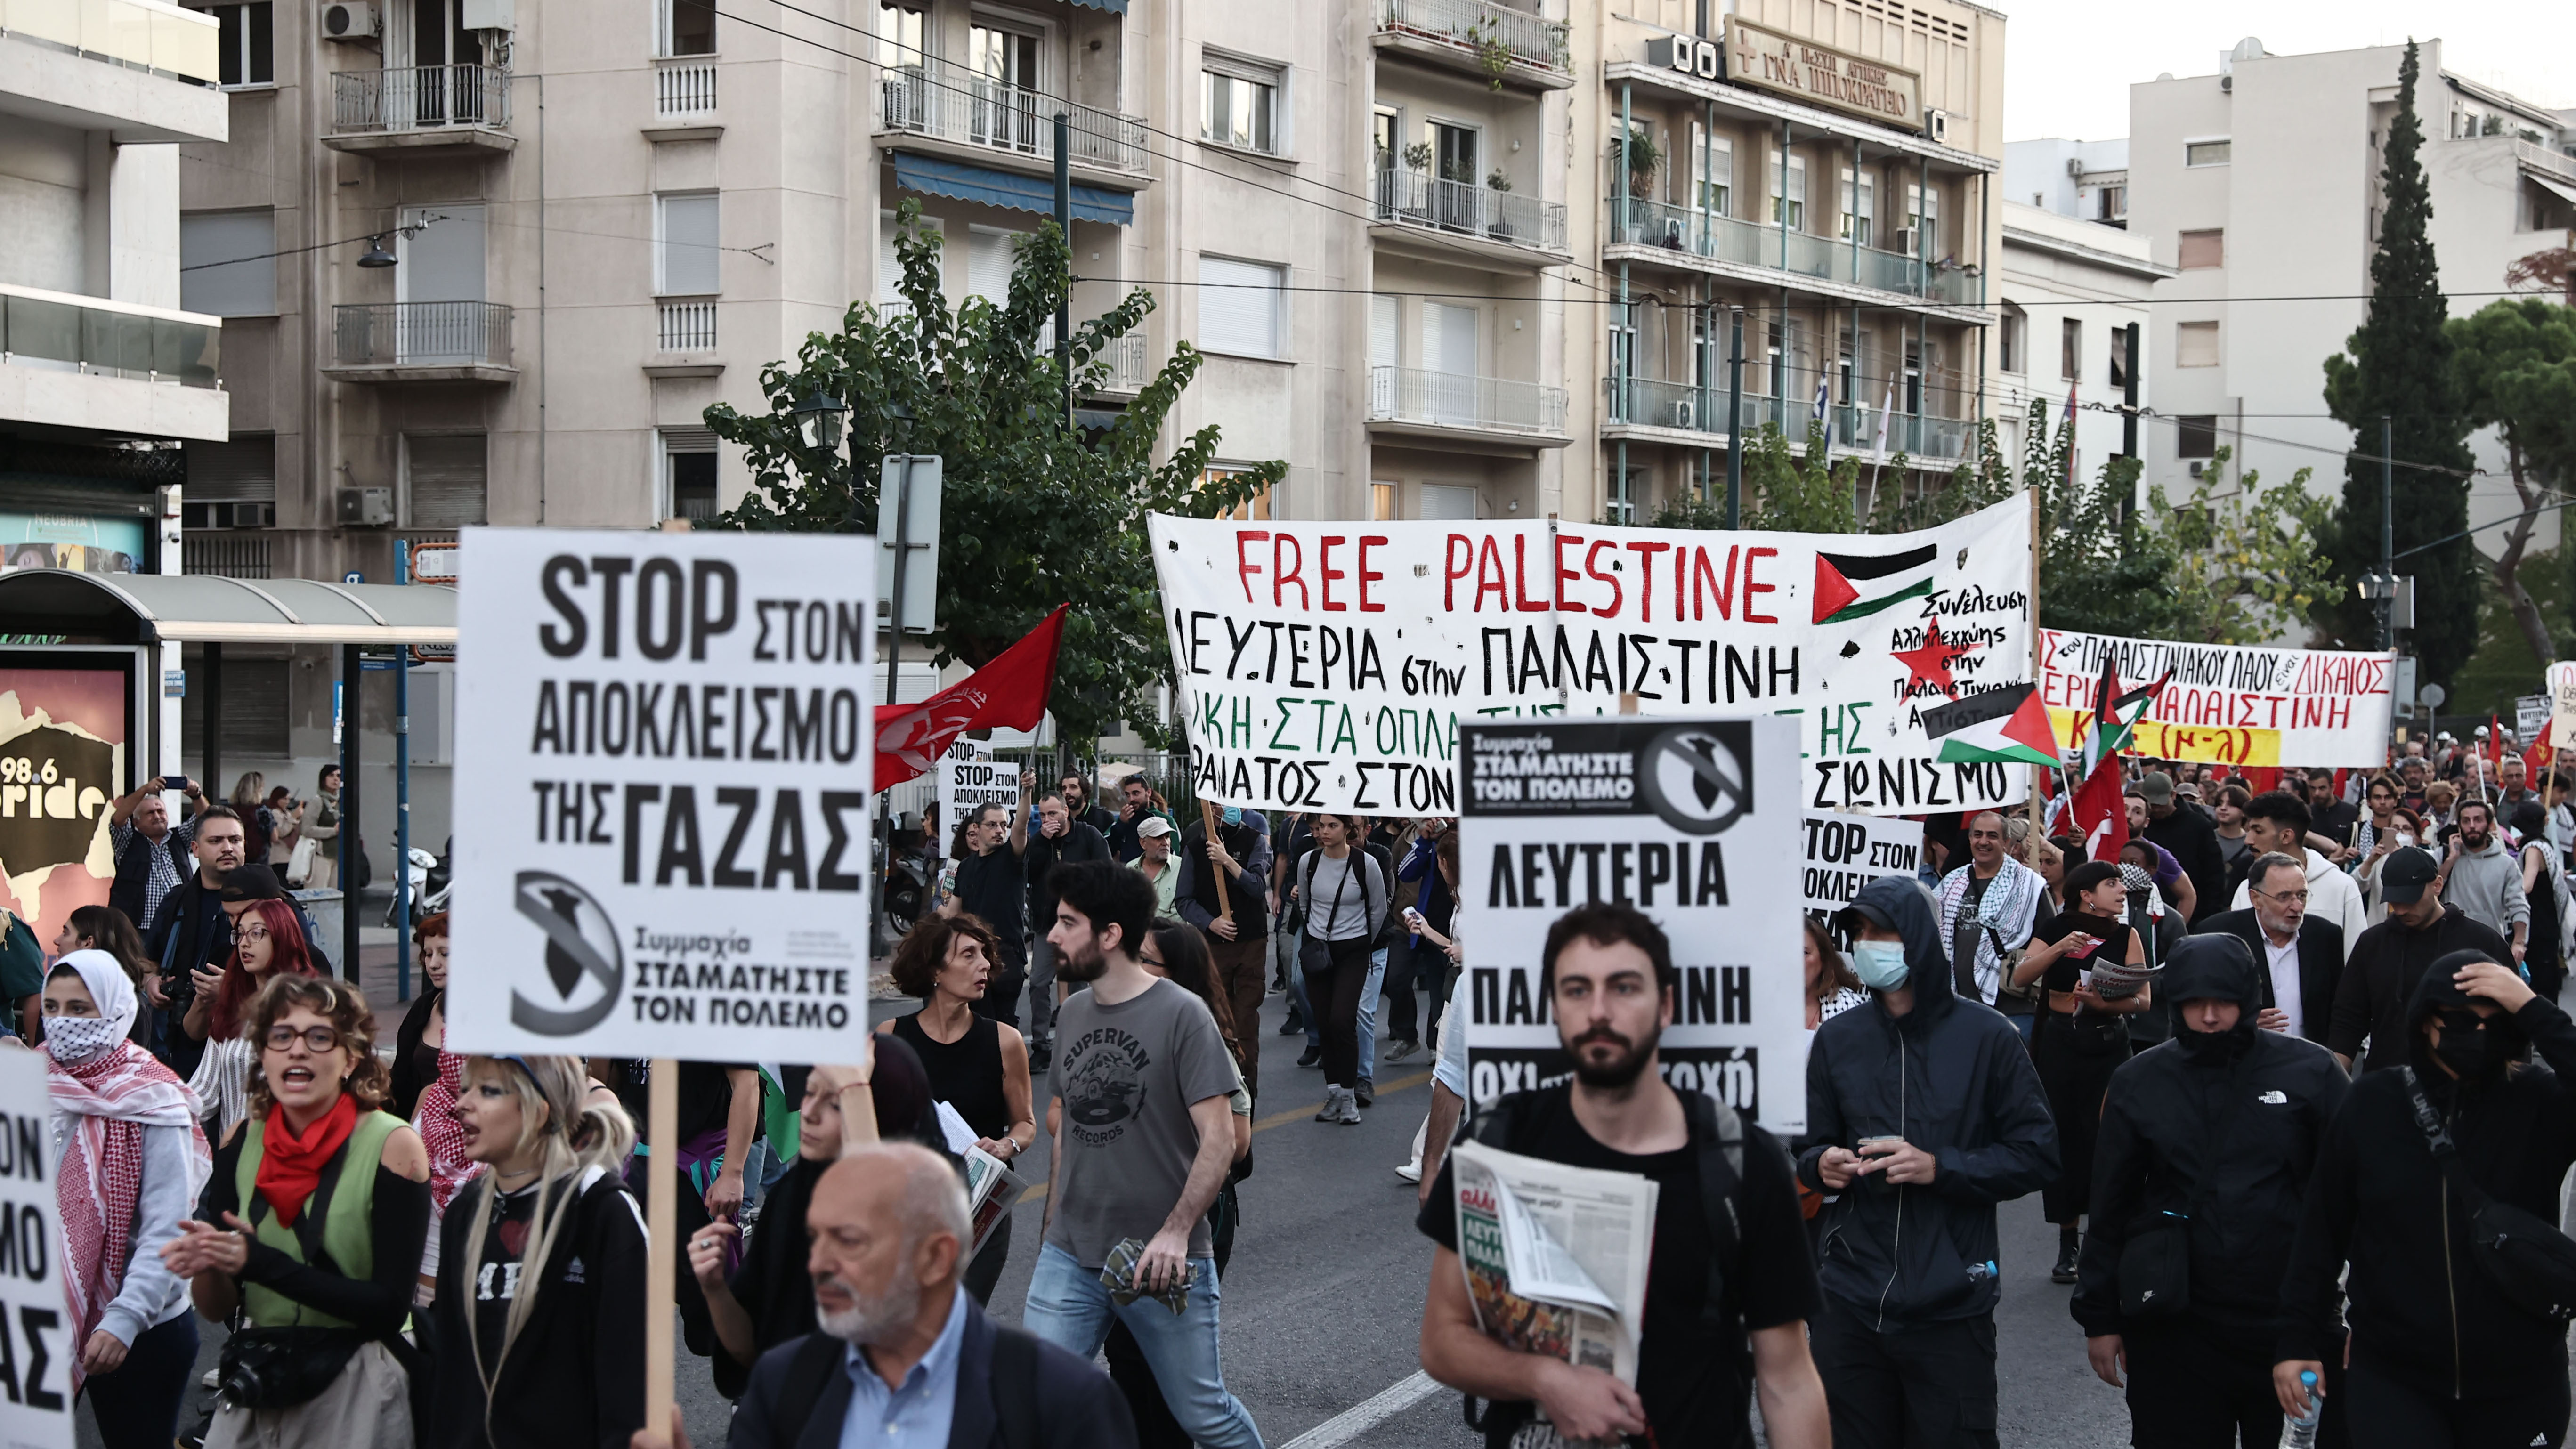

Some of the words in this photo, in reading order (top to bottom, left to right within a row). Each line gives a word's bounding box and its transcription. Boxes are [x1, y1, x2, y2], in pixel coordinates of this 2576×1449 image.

[1809, 66, 1907, 117] ΙΠΠΟΚΡΑΤΕΙΟ
[1847, 62, 1888, 86] ΑΤΤΙΚΗΣ
[1236, 530, 1389, 612] FREE
[1444, 532, 1779, 624] PALESTINE
[539, 554, 739, 662] STOP
[753, 598, 864, 664] ΣΤΟΝ
[1920, 584, 2027, 622] Συνέλευση
[1482, 624, 1799, 704] ΠΑΛΑΙΣΤΙΝΗ
[2230, 650, 2279, 692] ΛΑΟΥ
[2295, 654, 2392, 695] ΔΙΚΑΙΟΣ
[531, 679, 859, 765] ΑΠΟΚΛΕΙΣΜΟ
[1268, 697, 1357, 755] ΣΤΑ
[0, 756, 58, 785] 98.6
[948, 741, 974, 761] STOP
[1473, 752, 1634, 777] ΣΤΑΜΑΤΗΣΤΕ
[954, 788, 1016, 805] ΑΠΟΚΛΕΙΣΜΟ
[955, 765, 993, 786] STOP
[995, 774, 1017, 786] ΣΤΟΝ
[1353, 762, 1456, 812] ΣΤΟΝ
[1472, 778, 1523, 801] ΤΟΝ
[1528, 776, 1635, 800] ΠΟΛΕΜΟ
[0, 777, 105, 820] ride
[532, 780, 614, 845] ΤΗΣ
[622, 782, 864, 894] ΓΑΖΑΣ
[1801, 818, 1866, 864] TOP
[1869, 841, 1917, 871] ΣΤΟΝ
[1488, 841, 1730, 908] ΛΕΥΤΕΡΙΑ
[633, 925, 751, 961] Συμμαχία
[633, 961, 851, 995] ΣΤΑΜΑΤΗΣΤΕ
[633, 995, 695, 1024] ΤΟΝ
[709, 997, 851, 1029] ΠΟΛΕΜΟ
[1063, 1028, 1150, 1072] SUPERVAN
[1072, 1124, 1124, 1143] RECORDS
